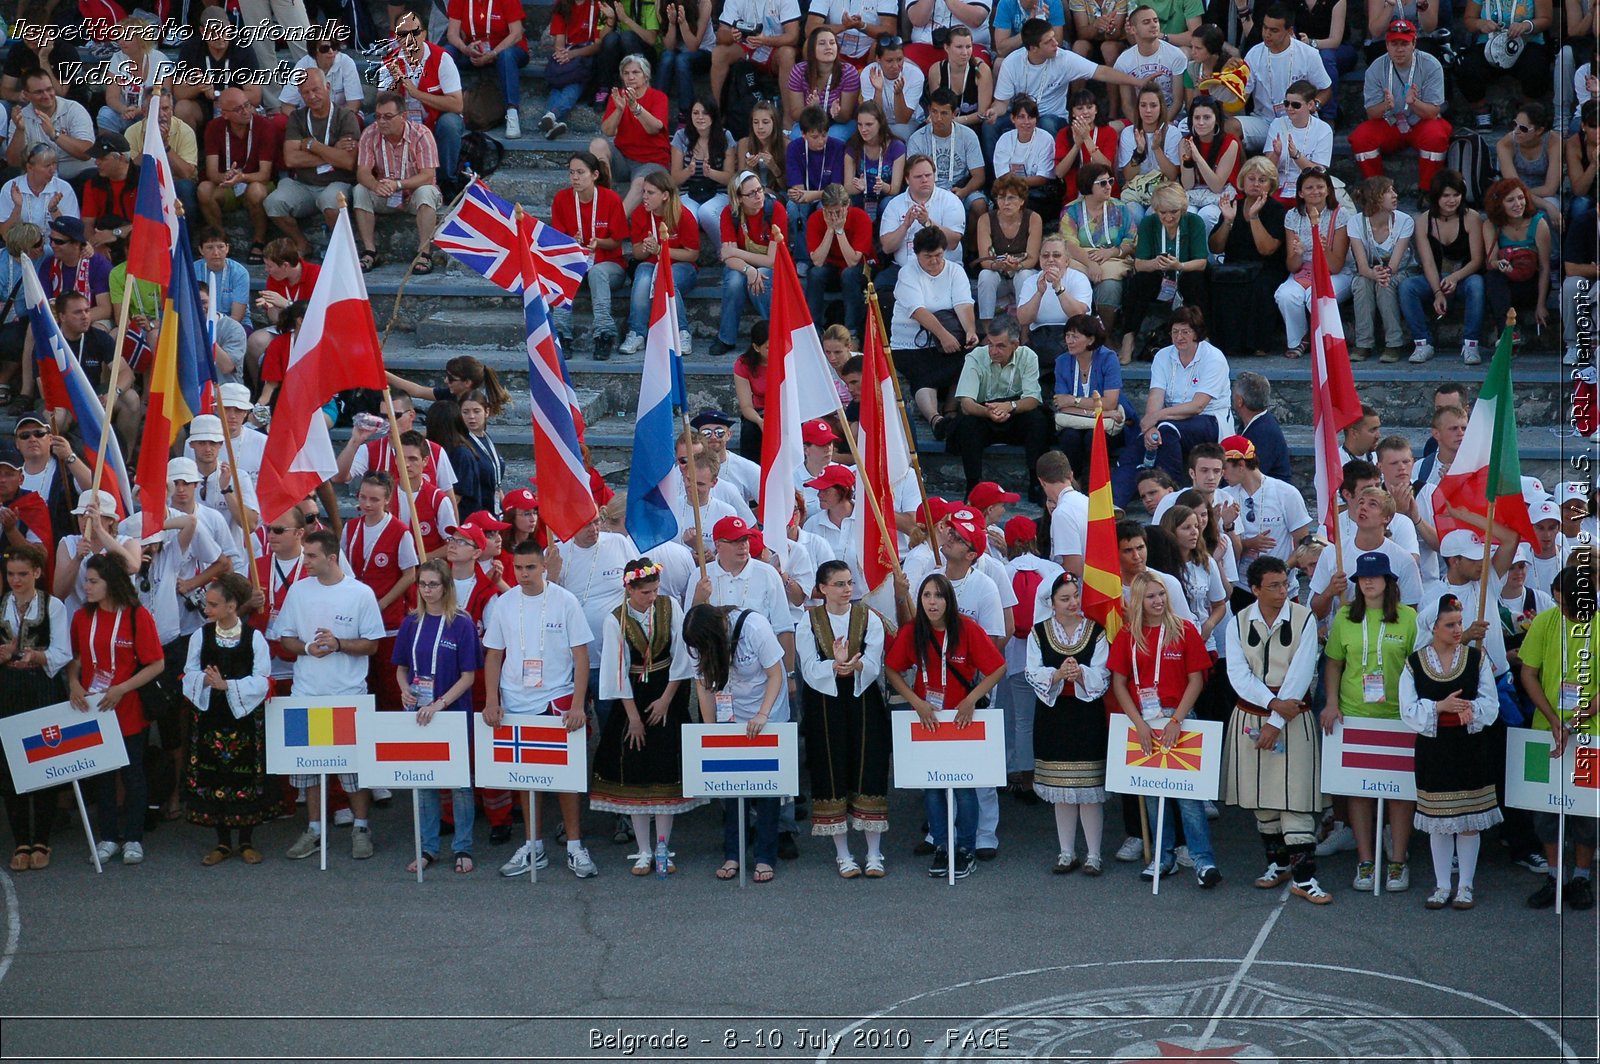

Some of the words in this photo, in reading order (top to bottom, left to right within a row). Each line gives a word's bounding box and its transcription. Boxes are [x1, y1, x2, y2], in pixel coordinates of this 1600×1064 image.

[45, 758, 96, 778] Slovakia
[297, 756, 347, 767] Romania
[394, 770, 434, 782] Poland
[509, 772, 553, 786] Norway
[927, 771, 974, 782] Monaco
[704, 780, 778, 792] Netherlands
[1130, 776, 1194, 791] Macedonia
[1361, 779, 1401, 793] Latvia
[1547, 792, 1576, 809] Italy
